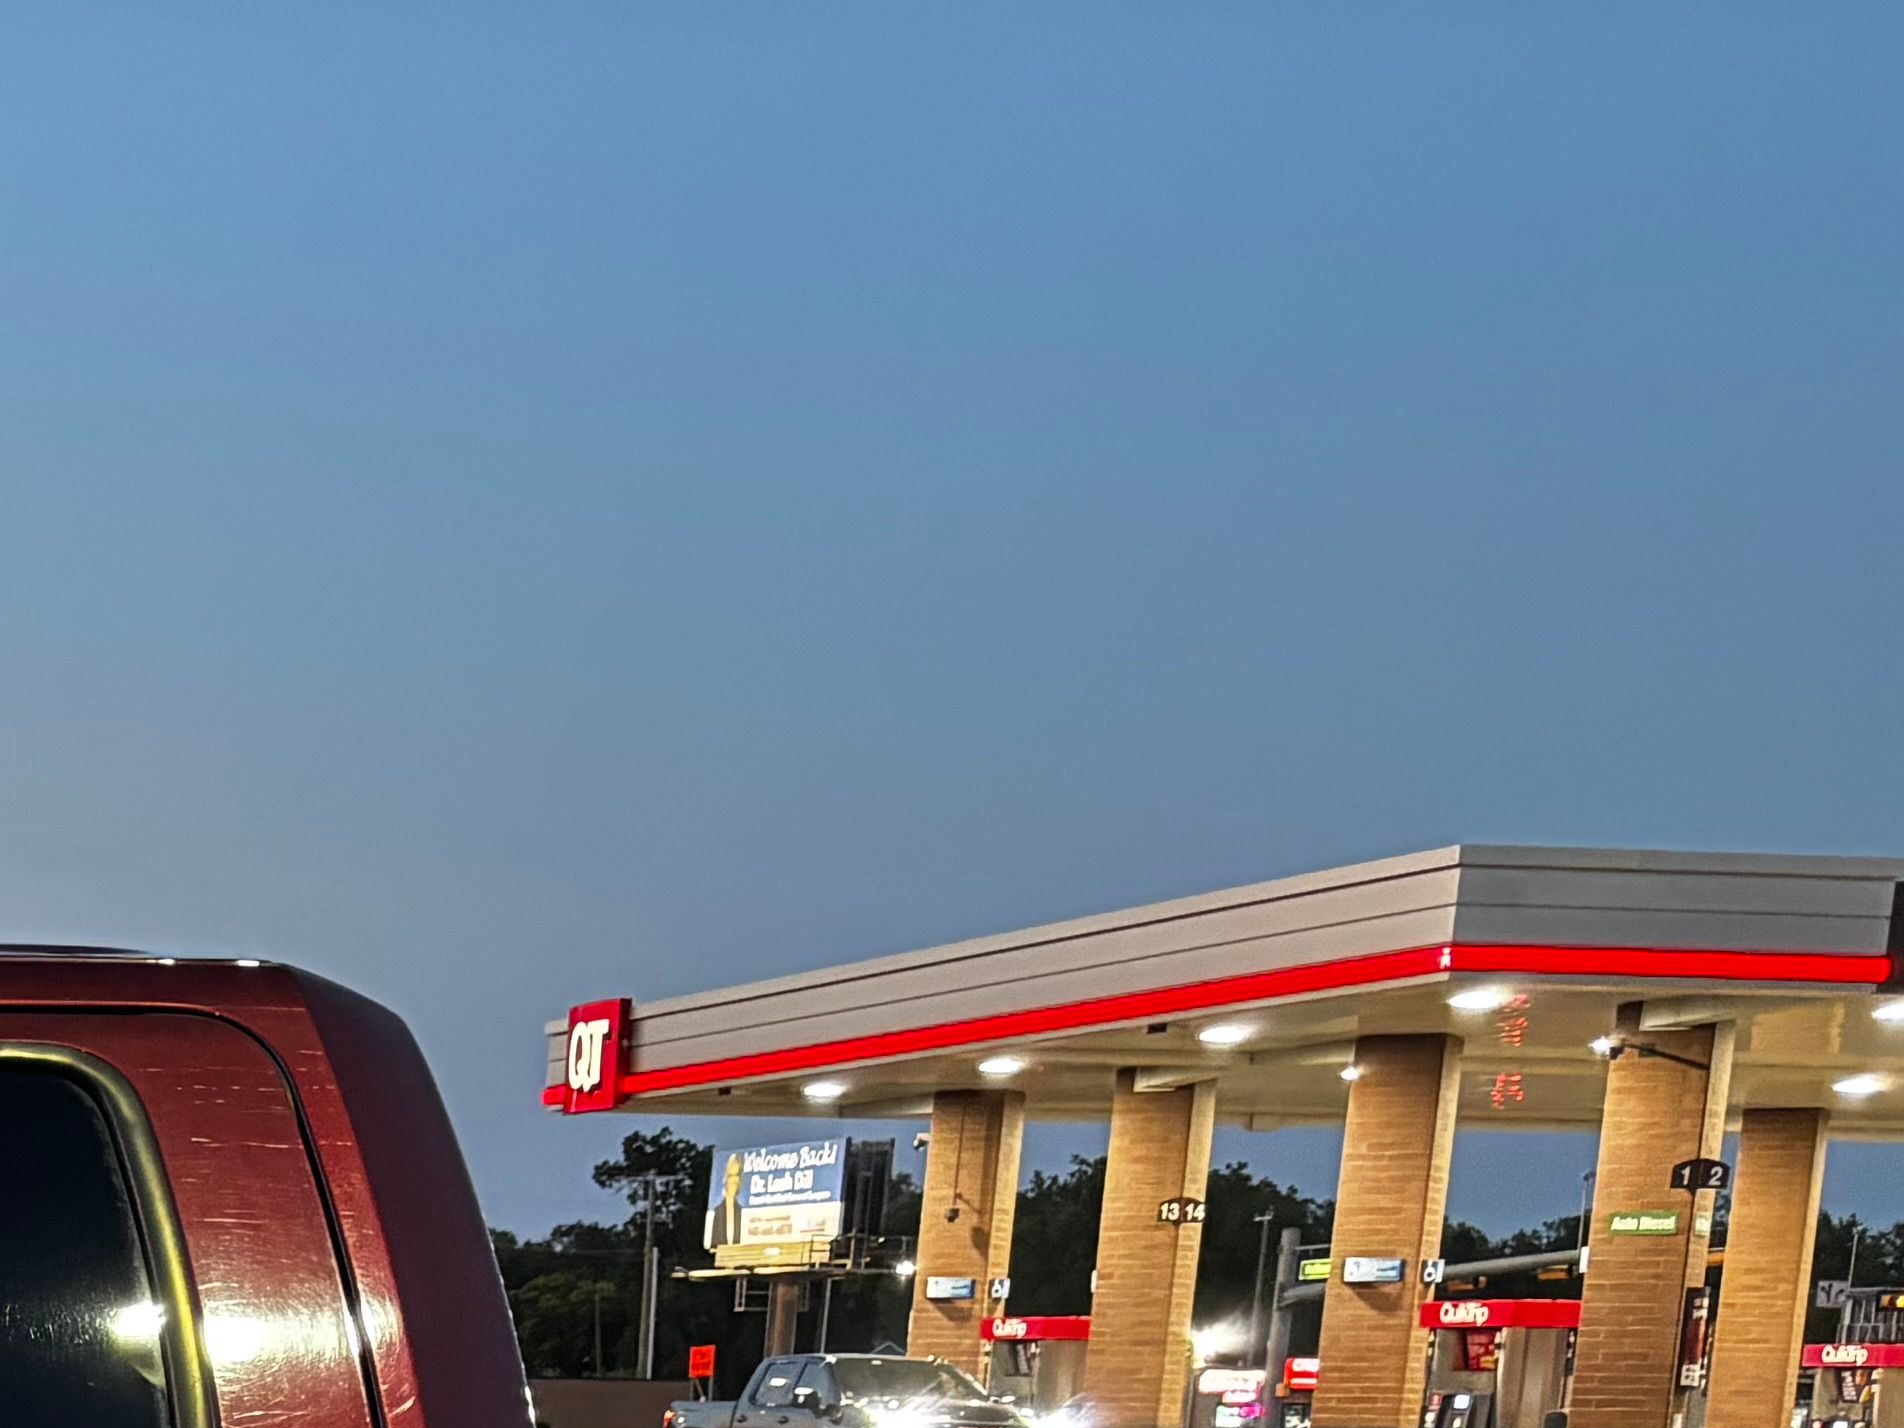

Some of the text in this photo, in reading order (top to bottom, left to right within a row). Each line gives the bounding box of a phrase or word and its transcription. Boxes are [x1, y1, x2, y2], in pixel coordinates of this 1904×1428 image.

[568, 1018, 610, 1093] QT
[743, 1148, 799, 1172] Welcome
[1681, 1166, 1691, 1186] 1
[1708, 1166, 1723, 1186] 2
[1160, 1202, 1180, 1220] 13
[1185, 1203, 1206, 1221] 14
